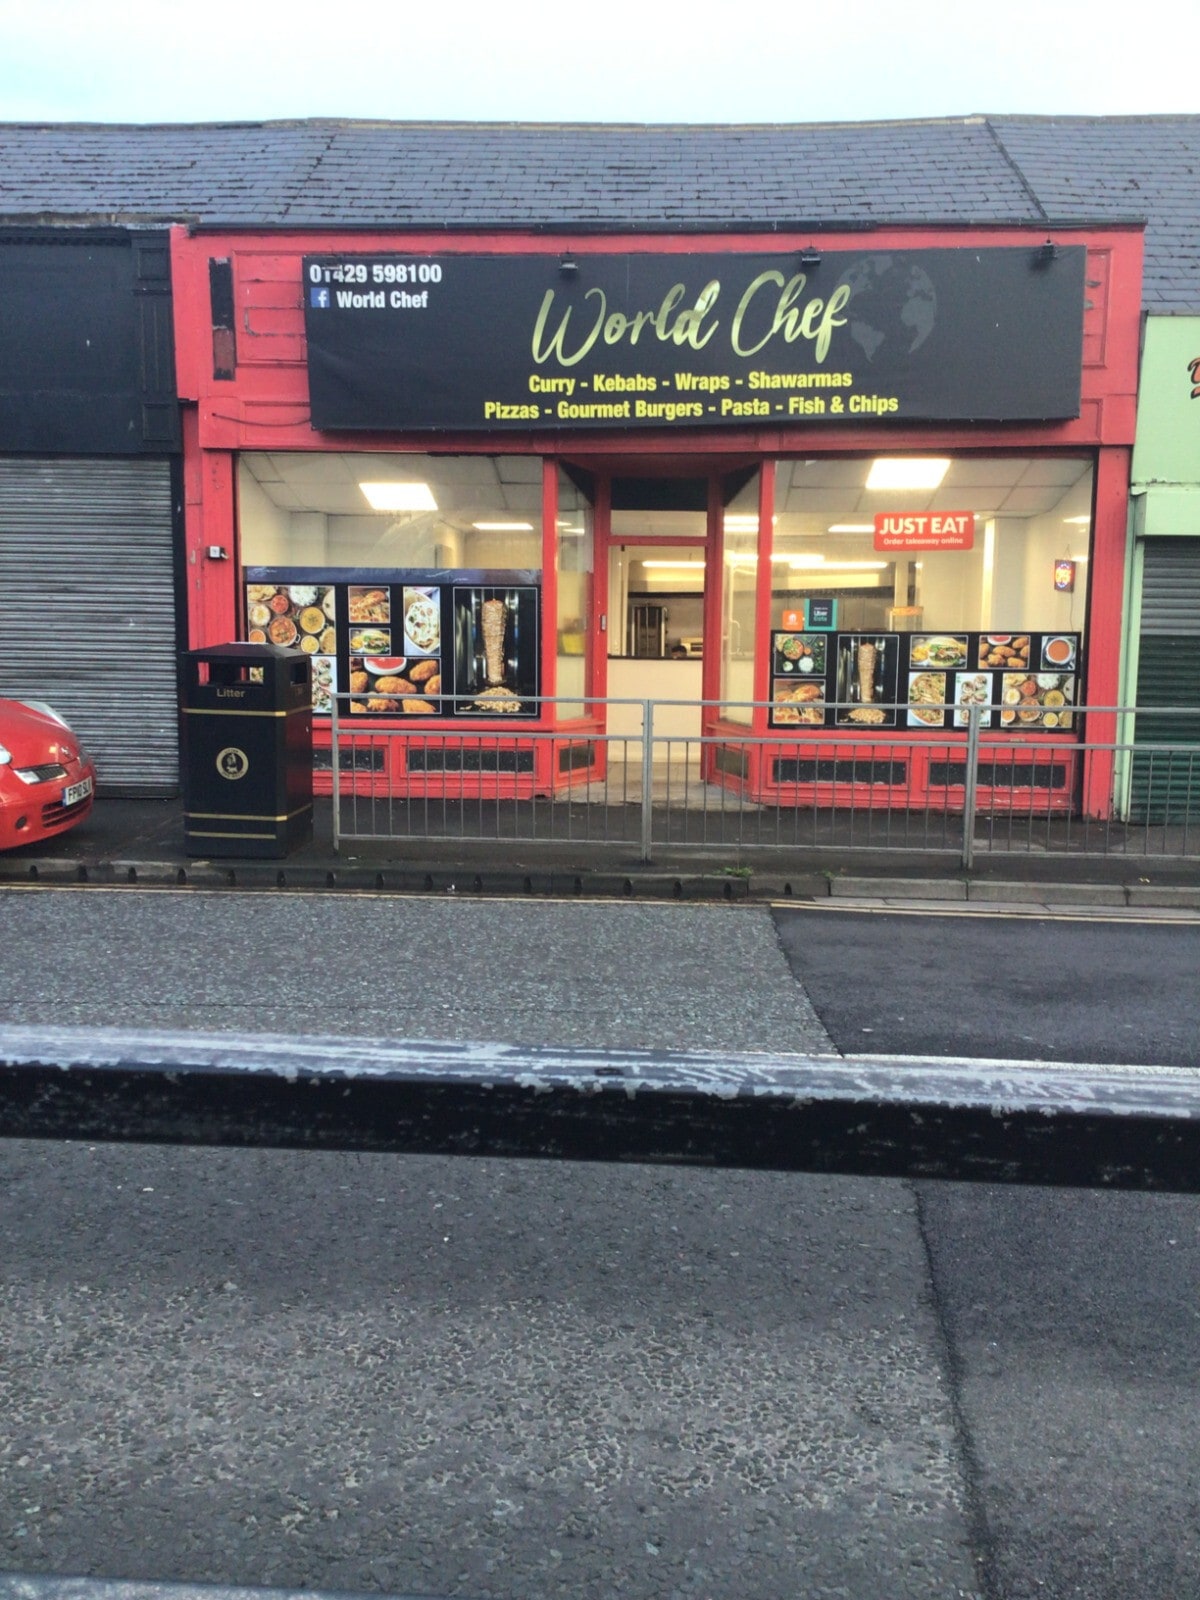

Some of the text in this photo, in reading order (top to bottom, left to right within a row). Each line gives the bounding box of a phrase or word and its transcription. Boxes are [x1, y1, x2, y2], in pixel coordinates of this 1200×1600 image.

[309, 264, 442, 283] 01429 598100
[336, 290, 386, 309] World
[390, 290, 429, 309] Chef
[531, 270, 851, 367] World Chef
[528, 374, 576, 396] Curry
[593, 374, 657, 392] Kebabs
[674, 373, 731, 394] Wraps
[748, 371, 853, 389] Shawarmas
[484, 401, 540, 419] Pizzas
[557, 400, 631, 419] Gourmet
[635, 399, 704, 421] Burgers
[720, 398, 771, 416] Pasta
[788, 396, 826, 415] Fish
[829, 396, 845, 414] &
[848, 394, 899, 416] Chips
[879, 516, 969, 535] JUST EAT
[883, 538, 904, 546] Order
[905, 538, 940, 546] takeaway
[216, 688, 246, 698] Litter
